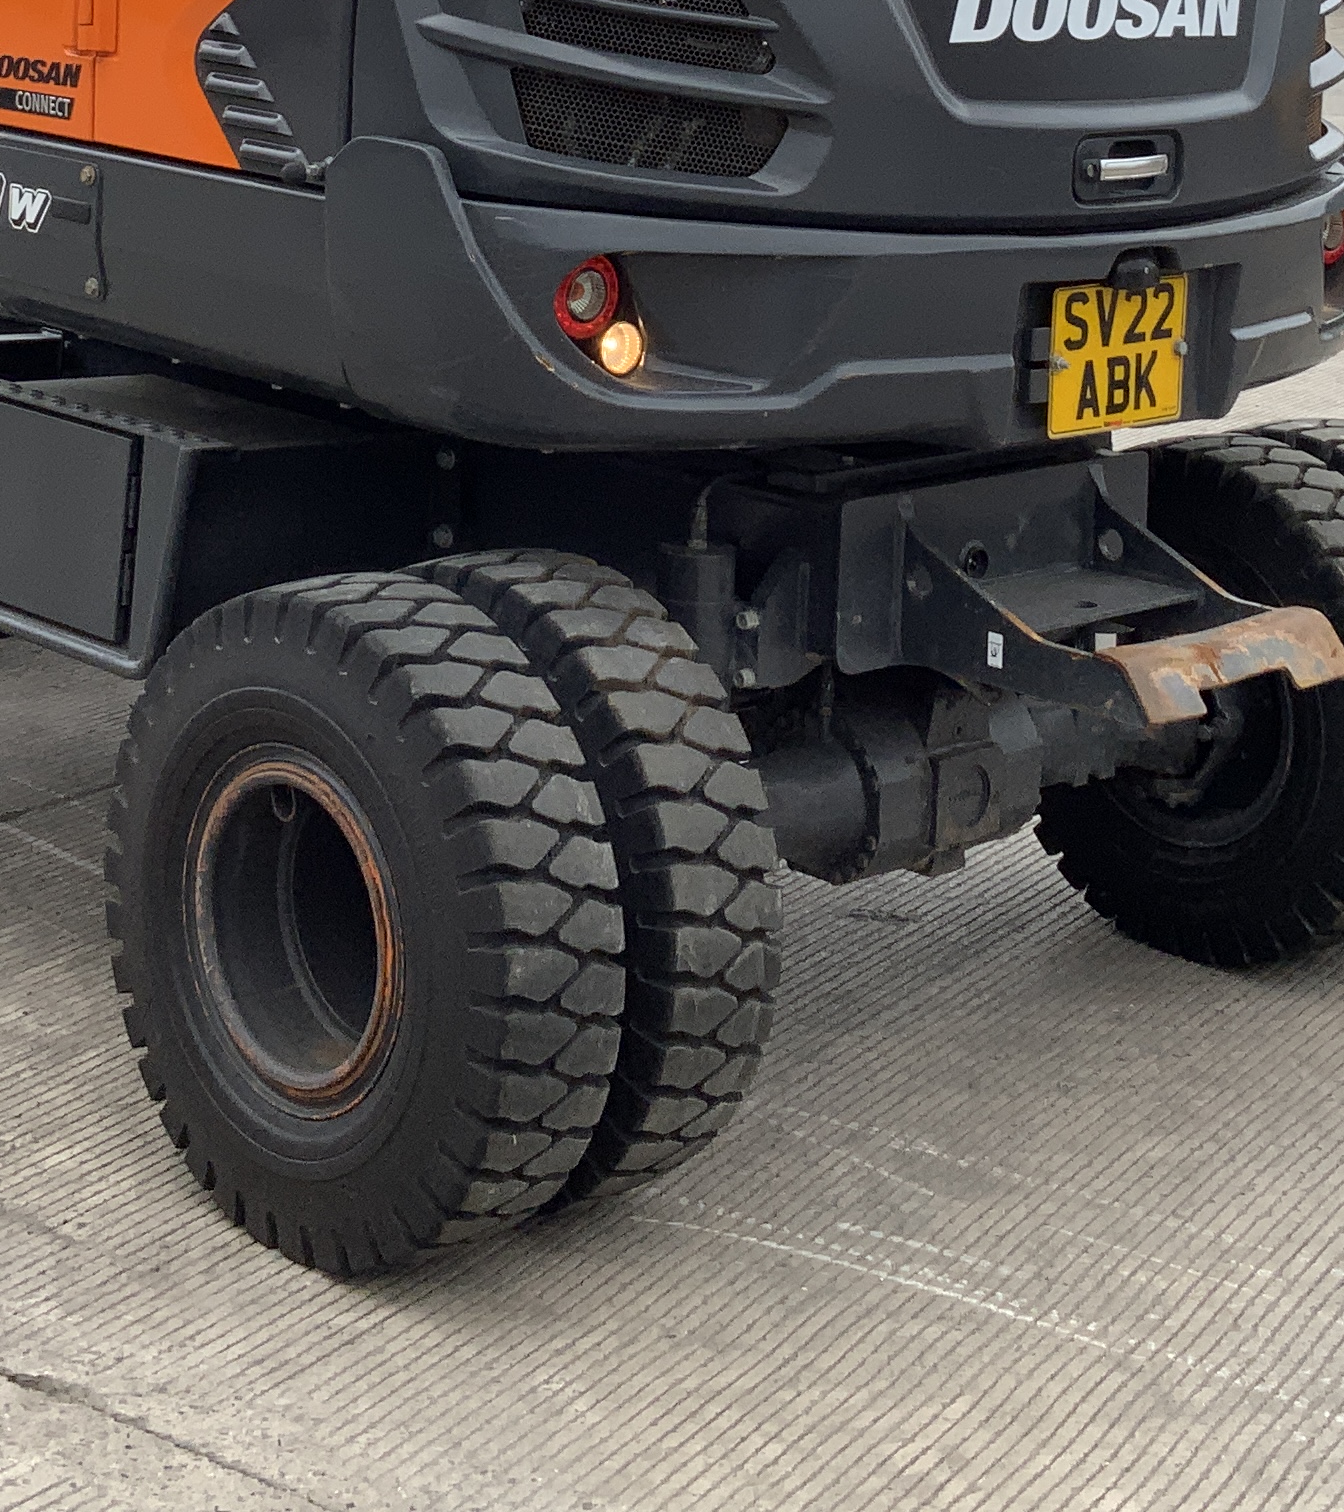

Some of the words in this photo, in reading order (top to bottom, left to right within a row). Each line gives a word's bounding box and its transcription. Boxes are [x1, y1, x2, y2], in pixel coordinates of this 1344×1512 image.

[15, 90, 71, 118] CONNECT
[1063, 282, 1175, 351] SV22
[1075, 349, 1158, 421] ABK
